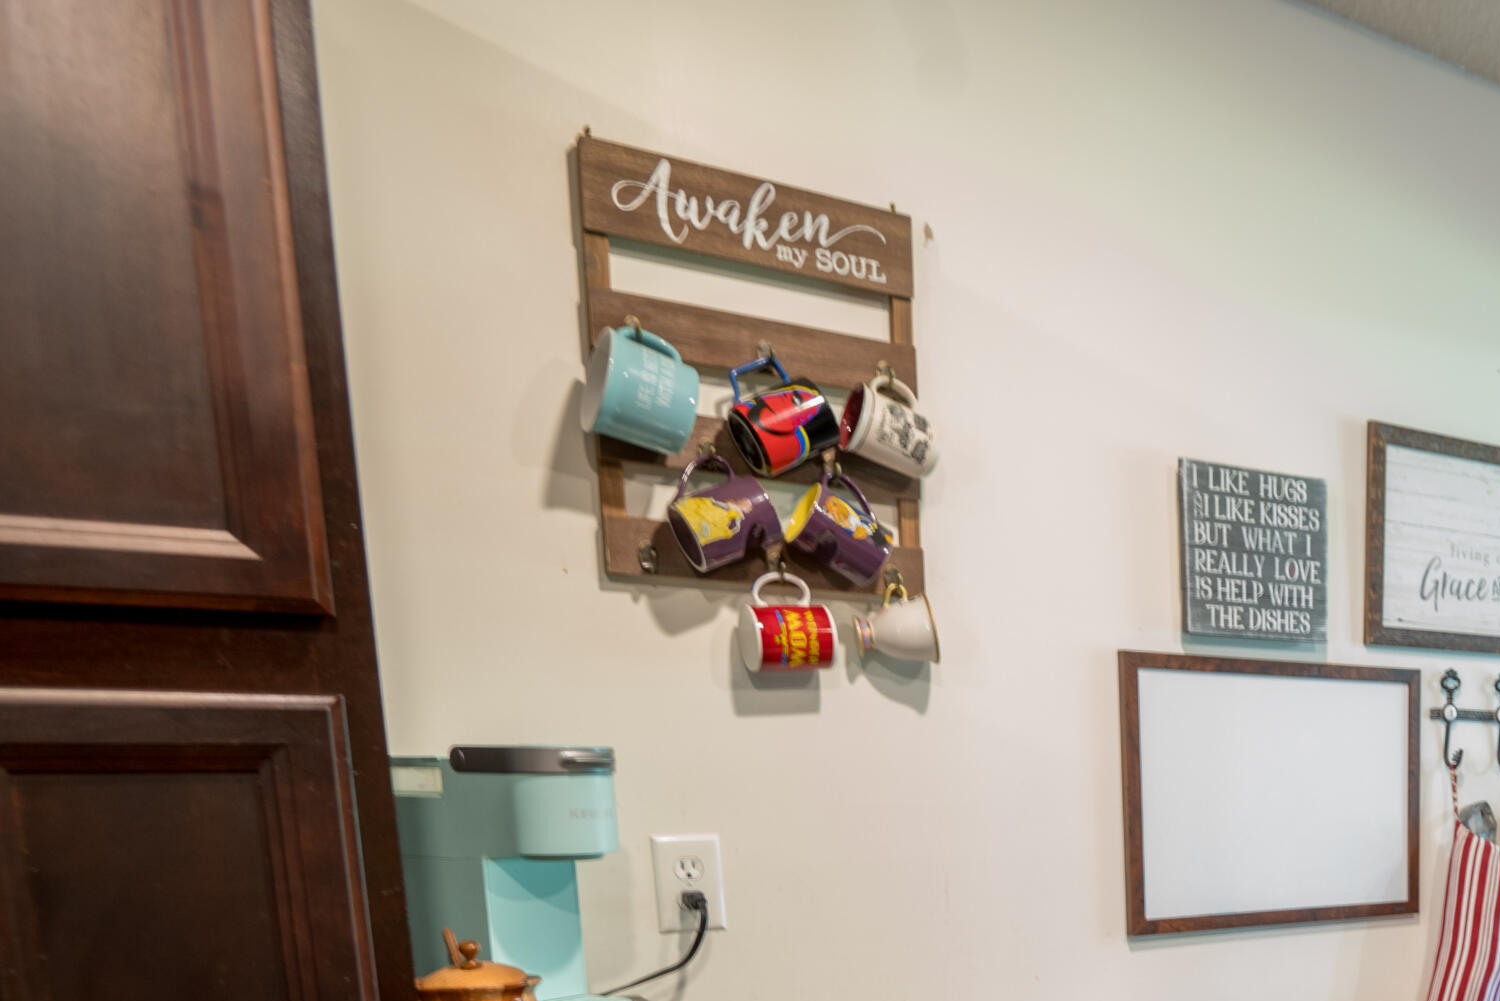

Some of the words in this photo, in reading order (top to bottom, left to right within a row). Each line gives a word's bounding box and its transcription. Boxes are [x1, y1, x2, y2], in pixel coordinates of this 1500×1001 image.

[611, 158, 887, 249] Awaken
[776, 244, 808, 268] my
[815, 248, 887, 284] SOUL
[1192, 463, 1198, 488] I
[1208, 466, 1249, 496] LIKE
[1258, 474, 1308, 504] HUGS
[1214, 495, 1256, 525] LIKE
[1259, 501, 1320, 532] KISSES
[1193, 520, 1232, 548] BUT
[1241, 526, 1297, 556] WHAT
[1305, 534, 1311, 557] I
[1194, 548, 1265, 578] REALLY
[1274, 557, 1321, 584] LOVE
[1419, 555, 1488, 612] Grace
[1194, 575, 1213, 600] IS
[1216, 577, 1264, 605] HELP
[1267, 582, 1314, 609] WITH
[1205, 604, 1245, 630] THE
[1249, 607, 1311, 634] DISHES
